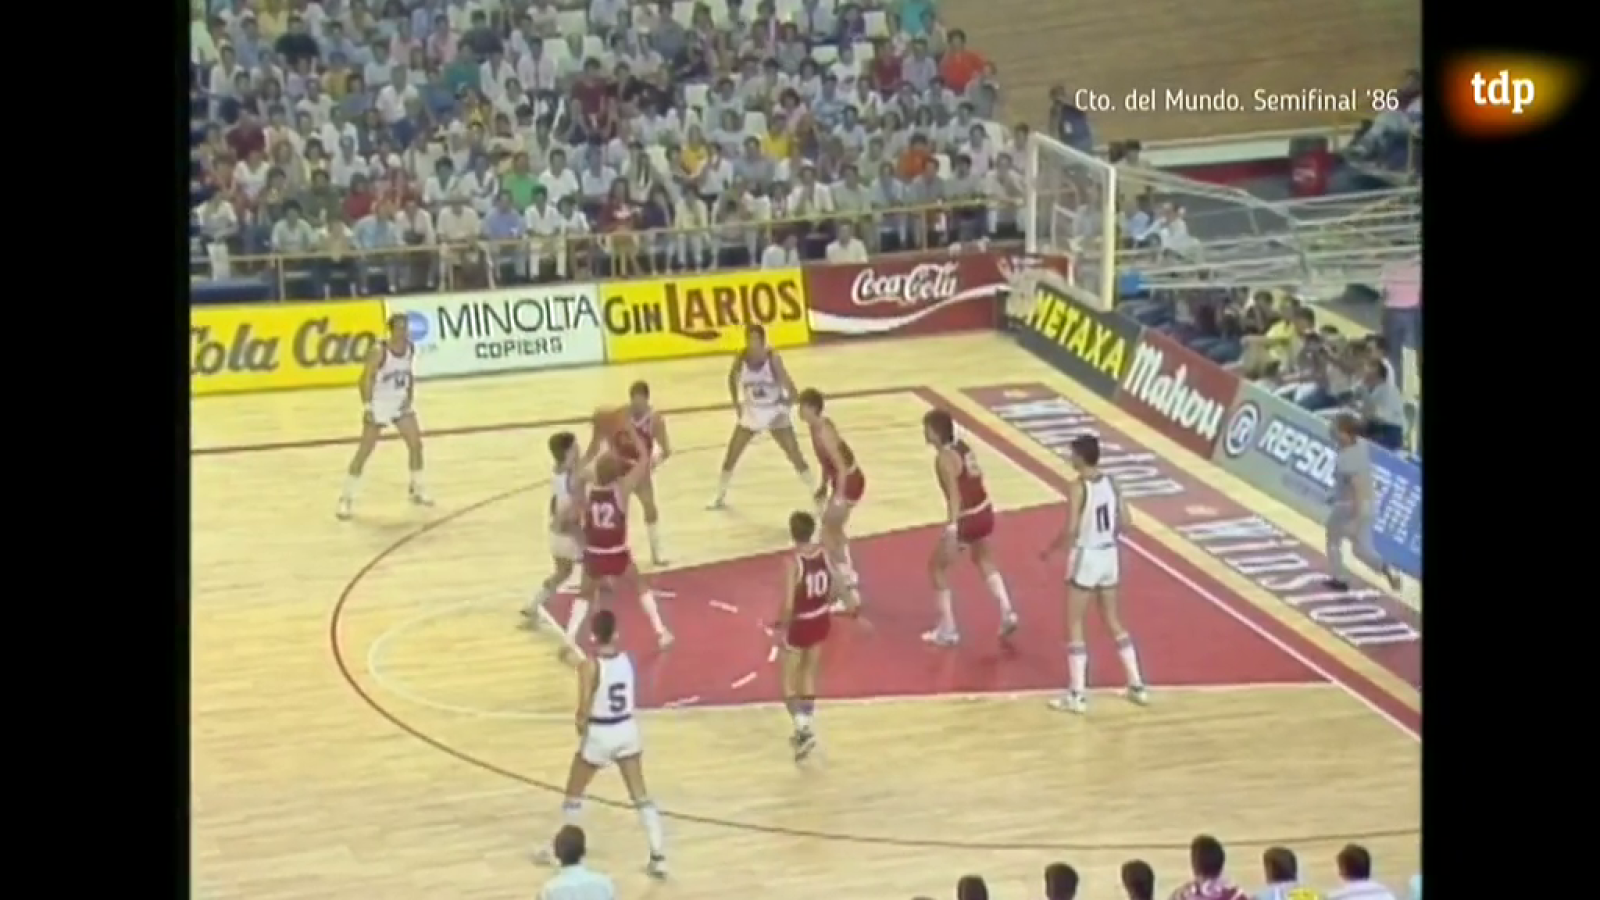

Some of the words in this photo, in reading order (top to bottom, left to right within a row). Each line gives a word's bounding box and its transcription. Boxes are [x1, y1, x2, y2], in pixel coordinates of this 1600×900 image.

[851, 261, 959, 305] Coca-Cola
[437, 294, 600, 340] MINOLTA
[664, 280, 803, 341] LARIOS
[292, 316, 377, 368] Cao
[475, 336, 564, 359] COPIERS
[1025, 288, 1126, 381] METAXA
[1122, 341, 1225, 441] Mahou
[592, 502, 615, 529] 12
[805, 571, 828, 599] 10
[608, 683, 628, 712] 5
